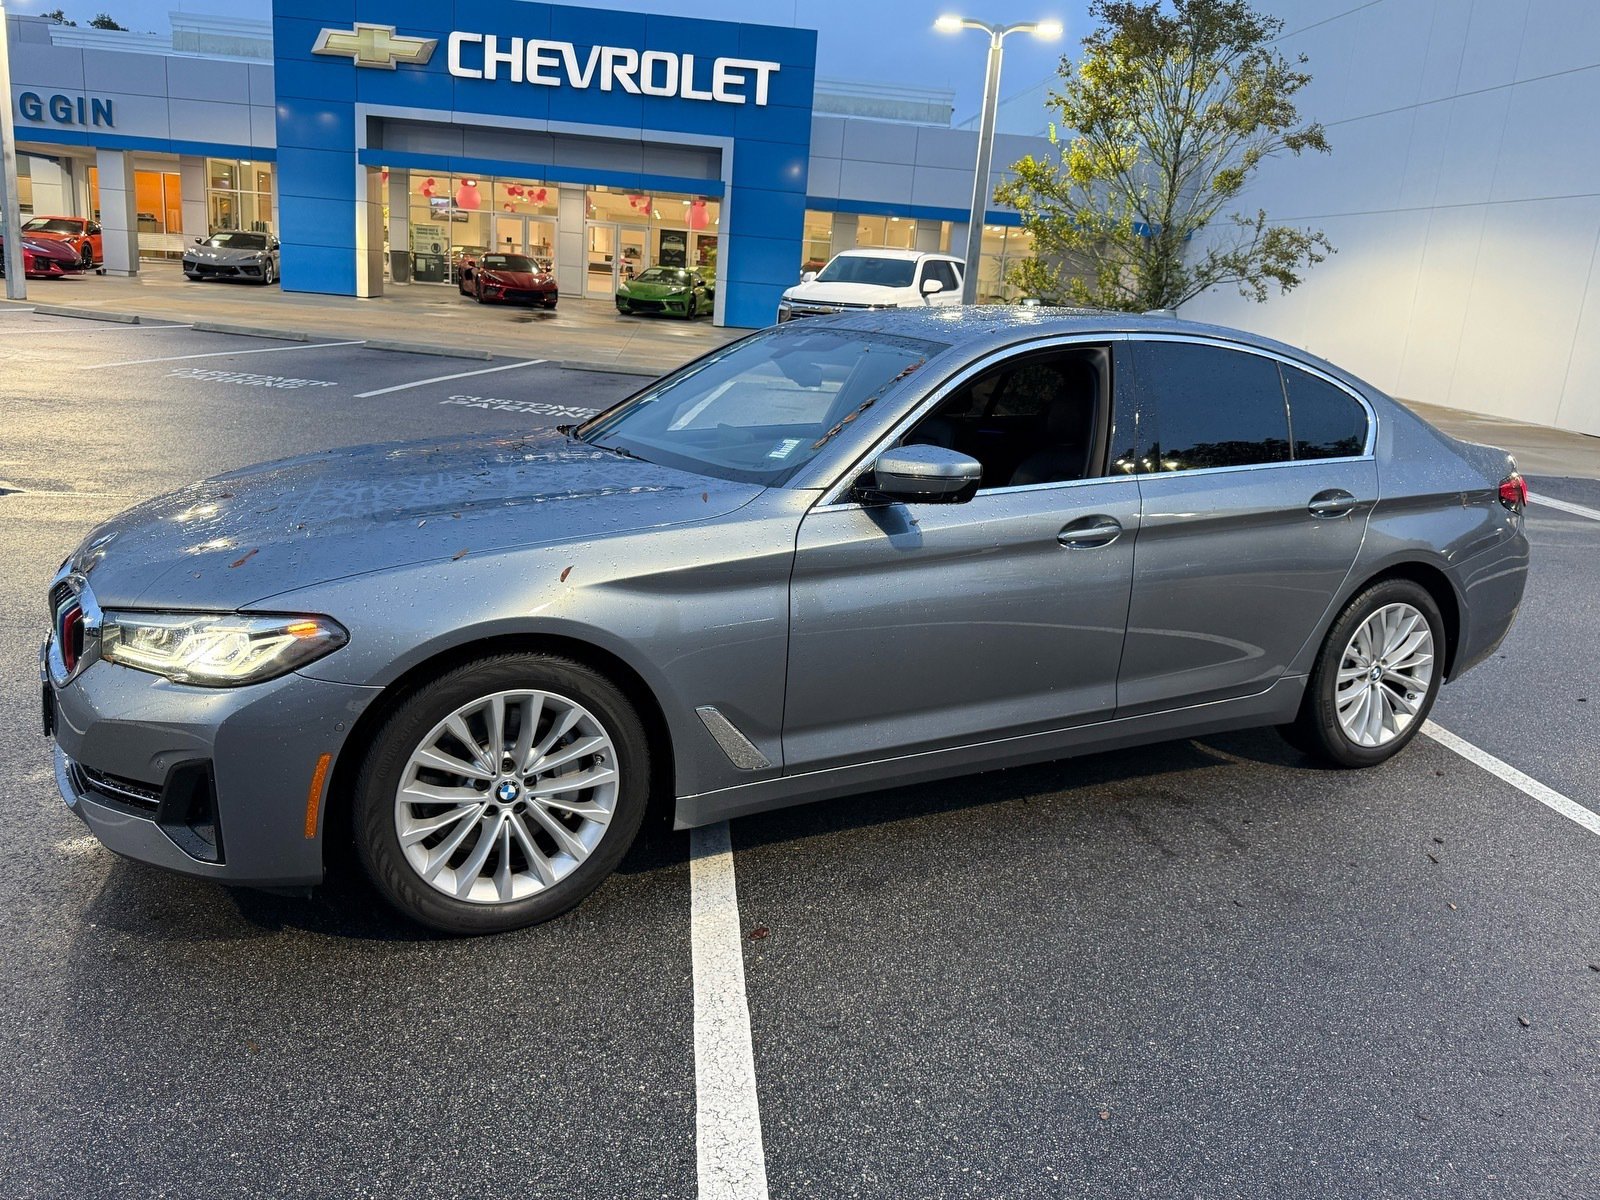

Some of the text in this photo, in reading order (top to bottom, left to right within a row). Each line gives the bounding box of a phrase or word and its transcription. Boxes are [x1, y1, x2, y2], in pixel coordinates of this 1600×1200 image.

[448, 31, 781, 106] CHEVROLET
[165, 373, 302, 389] PARKING
[172, 368, 339, 387] CUSTOMER
